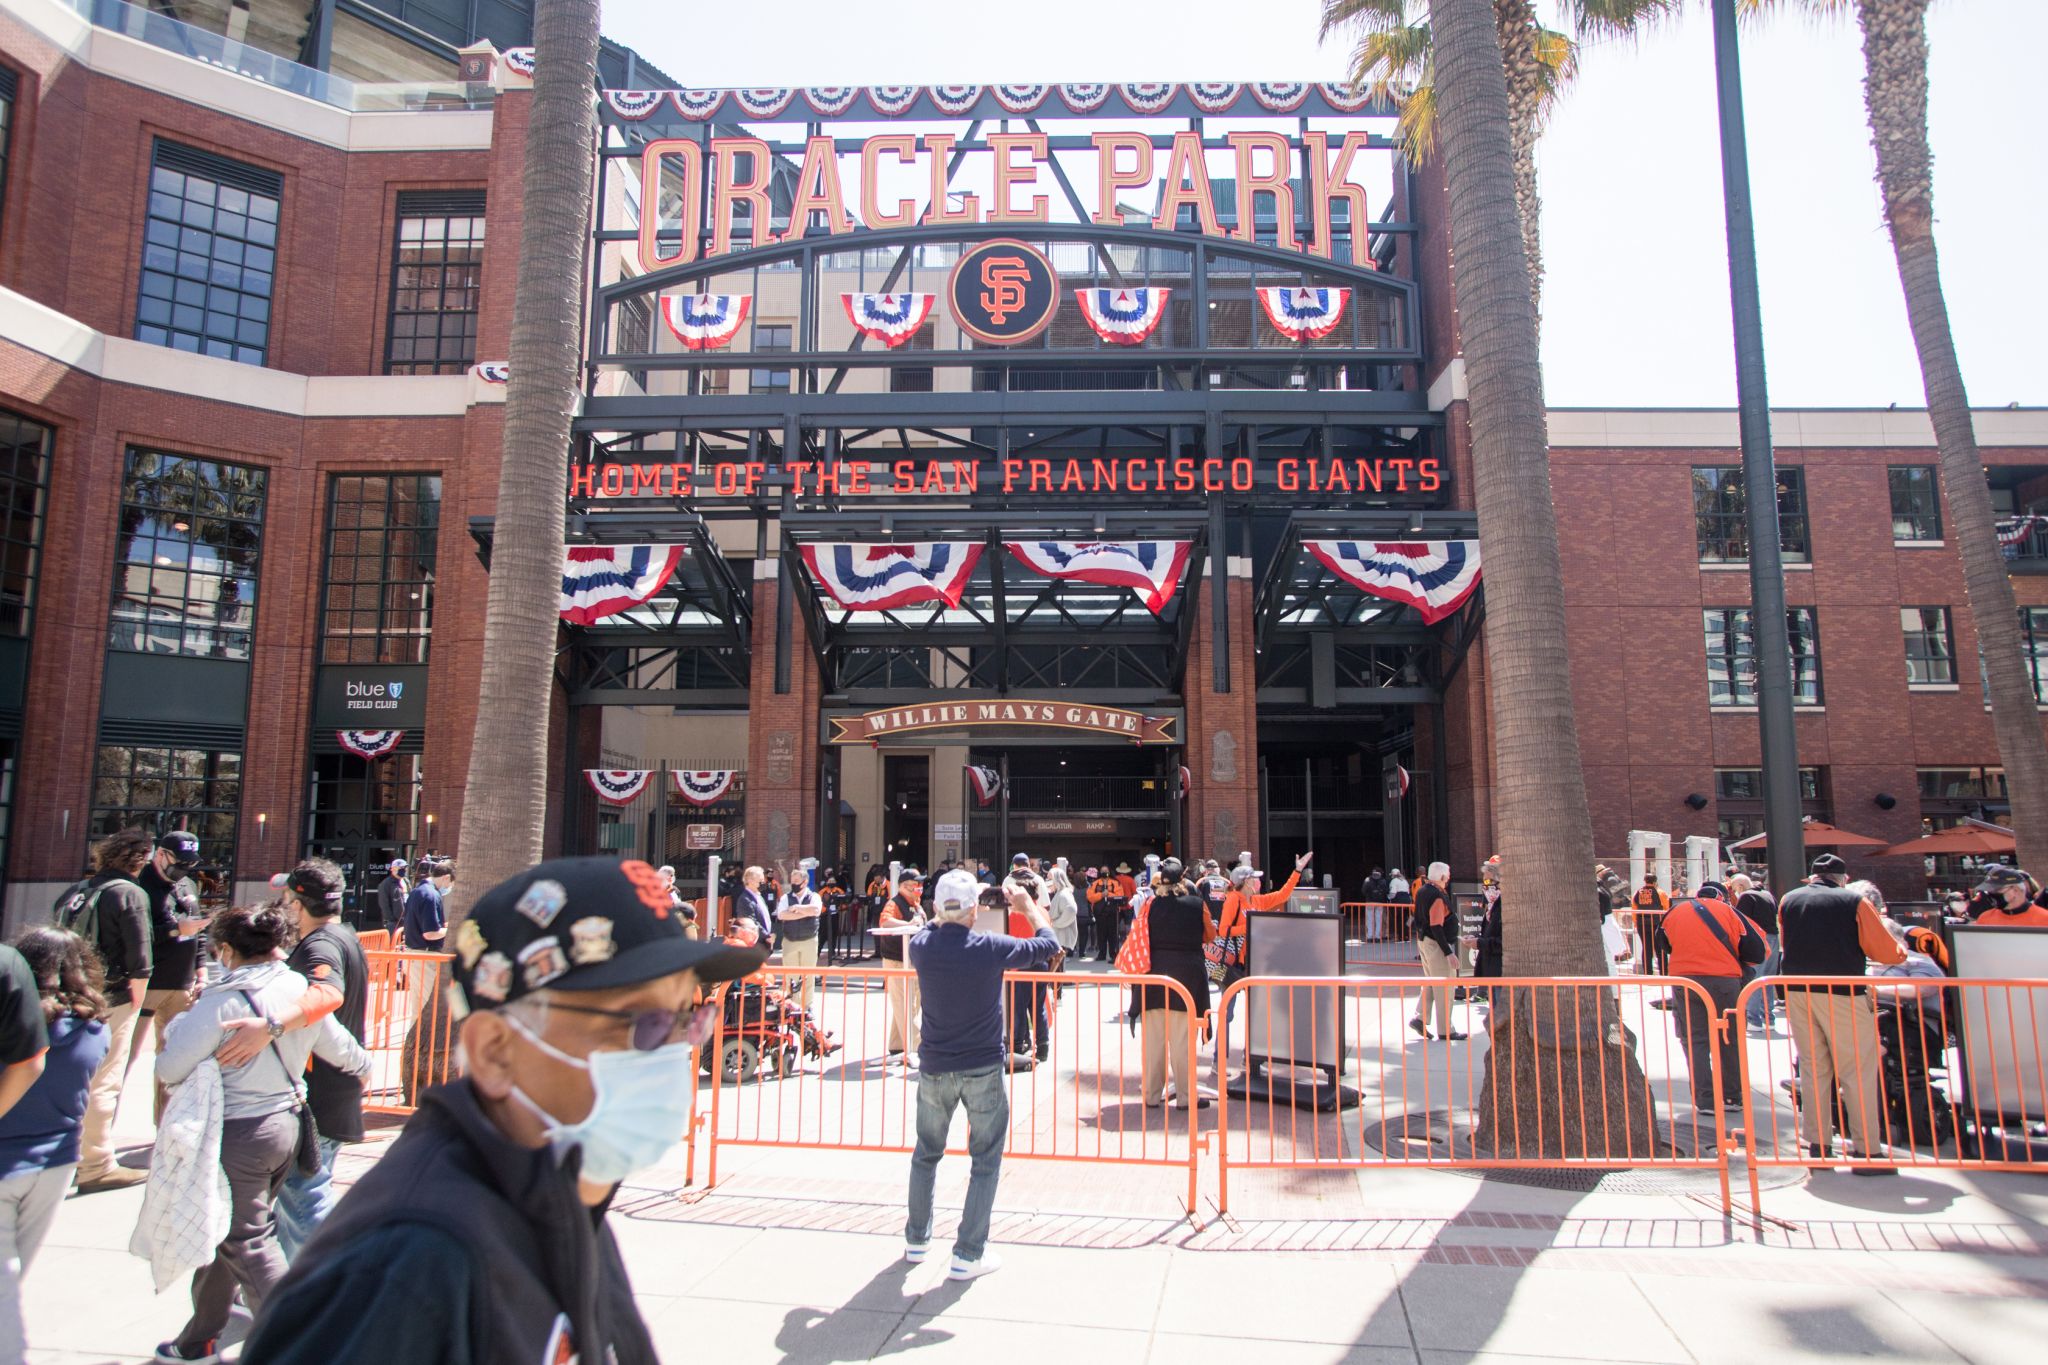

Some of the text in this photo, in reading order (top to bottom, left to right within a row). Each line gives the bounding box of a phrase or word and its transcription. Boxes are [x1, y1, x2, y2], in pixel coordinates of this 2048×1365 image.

[638, 131, 1377, 273] ORACLE PARK
[980, 256, 1031, 325] SF
[570, 458, 1441, 496] HOME OF THE SAN FRANCISCO GIANTS
[346, 681, 385, 696] blue
[348, 701, 398, 709] FIELD CLUB
[868, 704, 1138, 732] WILLIE MAYS GATE
